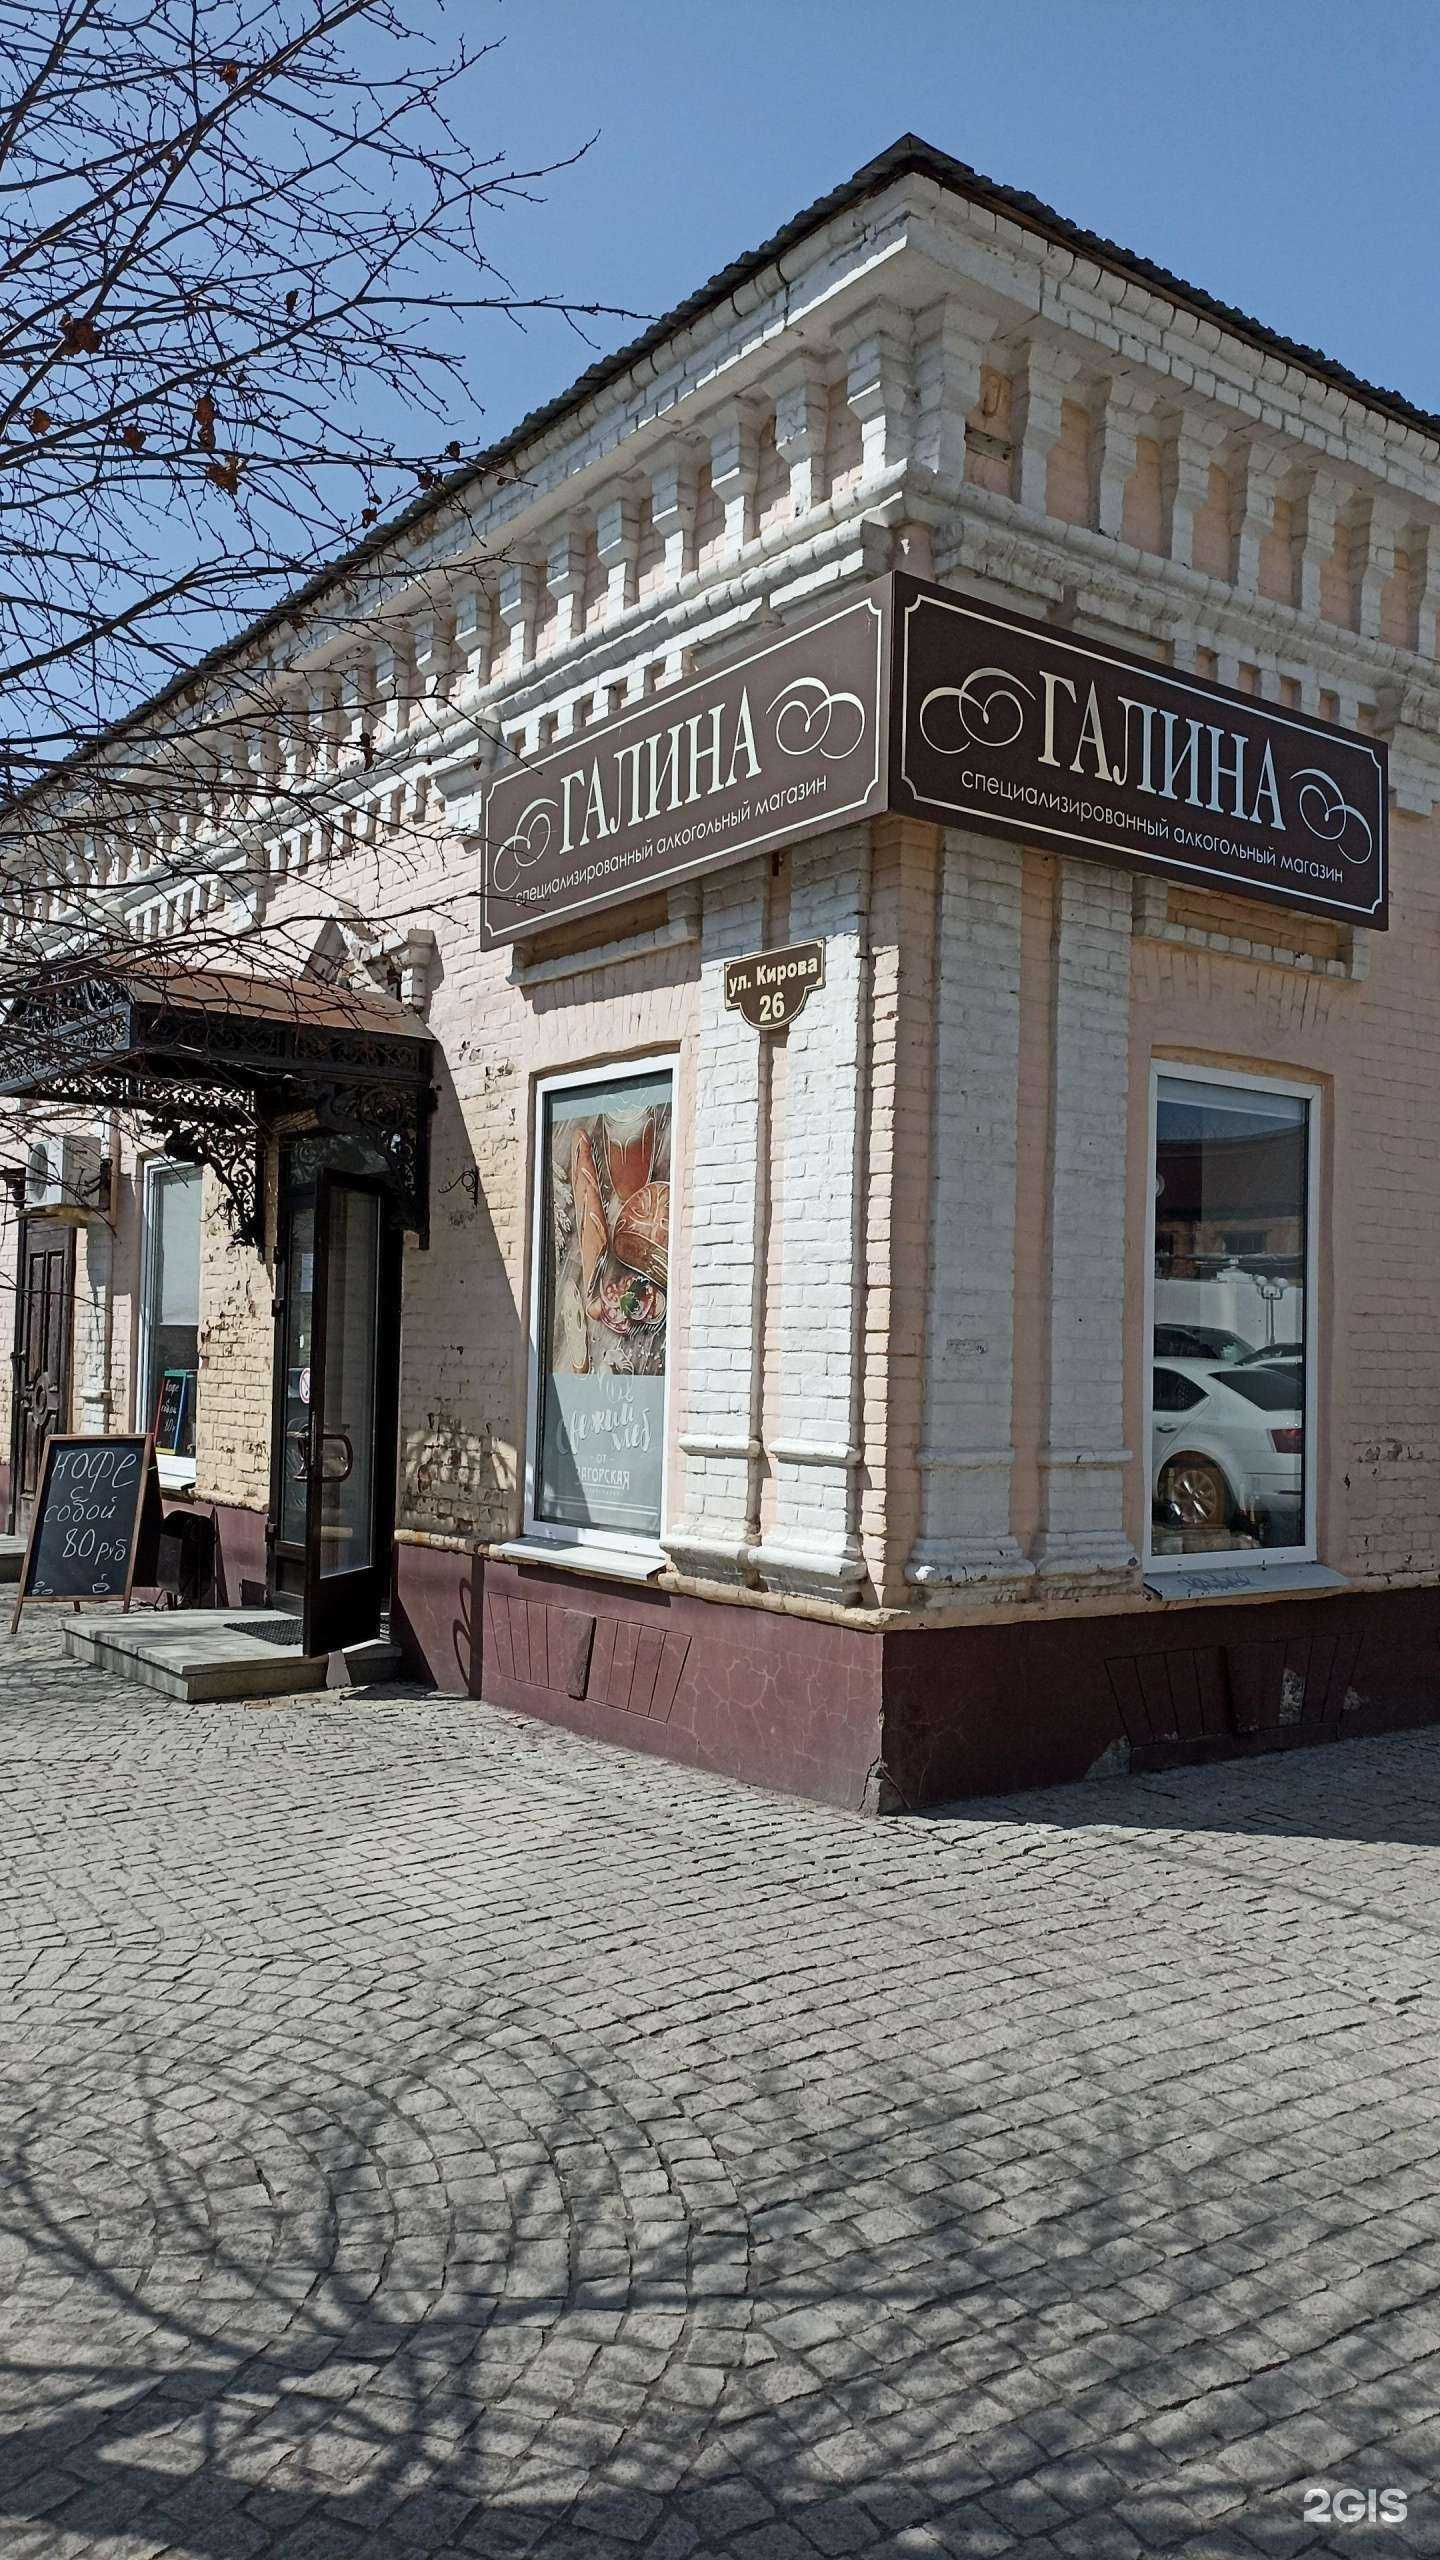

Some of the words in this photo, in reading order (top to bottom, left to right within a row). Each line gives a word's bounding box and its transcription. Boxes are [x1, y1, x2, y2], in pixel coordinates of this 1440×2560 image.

[559, 686, 762, 855] ГАЛИНА
[1037, 670, 1287, 831] ГАЛИНА
[515, 838, 654, 907] специализированный
[656, 800, 751, 853] алкогольный
[755, 774, 827, 816] магазин
[961, 770, 1170, 840] специализированный
[1173, 827, 1277, 867] алкогольный
[1280, 855, 1344, 883] магазин
[729, 974, 752, 998] ул.
[756, 957, 818, 985] Кирова
[760, 991, 785, 1021] 26
[44, 1497, 118, 1523] собой
